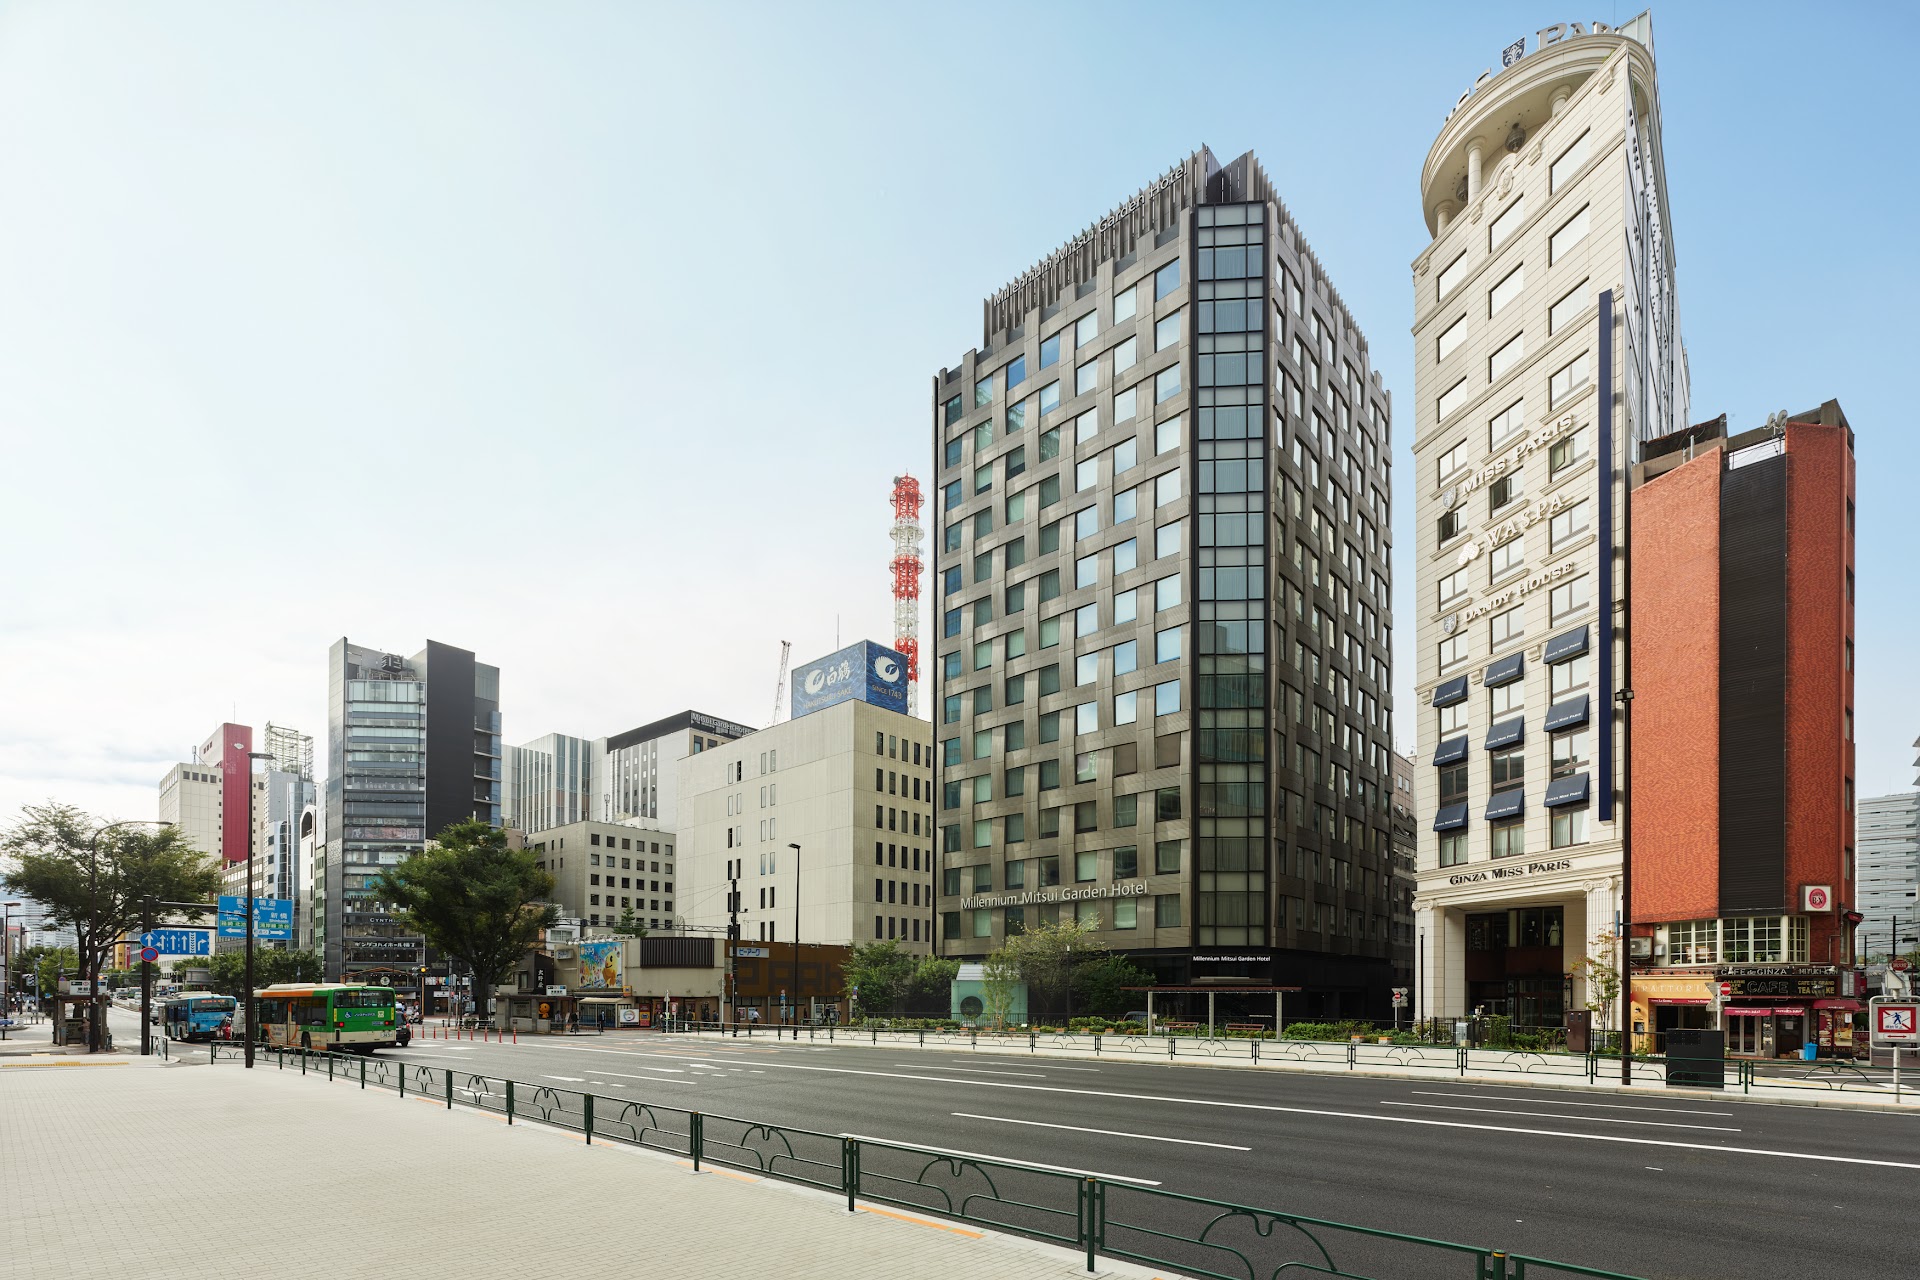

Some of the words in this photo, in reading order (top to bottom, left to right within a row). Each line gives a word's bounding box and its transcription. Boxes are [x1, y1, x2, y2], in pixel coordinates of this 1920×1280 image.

[993, 258, 1052, 307] Millennium
[1056, 228, 1095, 261] Mitsui
[1098, 194, 1145, 233] Garden
[1149, 160, 1187, 198] Hotel
[1461, 458, 1507, 496] MISS
[1511, 413, 1576, 462] PARIS
[1464, 591, 1514, 622] DANDY
[1516, 562, 1575, 597] HOUSE
[826, 660, 850, 686] 白鶴
[837, 687, 852, 698] SAKE
[872, 684, 887, 695] SINCE
[888, 688, 902, 699] 1743
[1449, 872, 1487, 885] GINZA
[1492, 867, 1523, 879] MISS
[1528, 860, 1570, 874] PARIS
[960, 894, 1017, 909] Millennium
[1022, 889, 1058, 904] Mitsui
[1062, 885, 1106, 900] Garden
[1112, 880, 1148, 896] Hotel
[739, 948, 760, 956] ピーアーク
[1757, 967, 1787, 975] GINZA
[1747, 980, 1789, 994] CAFE
